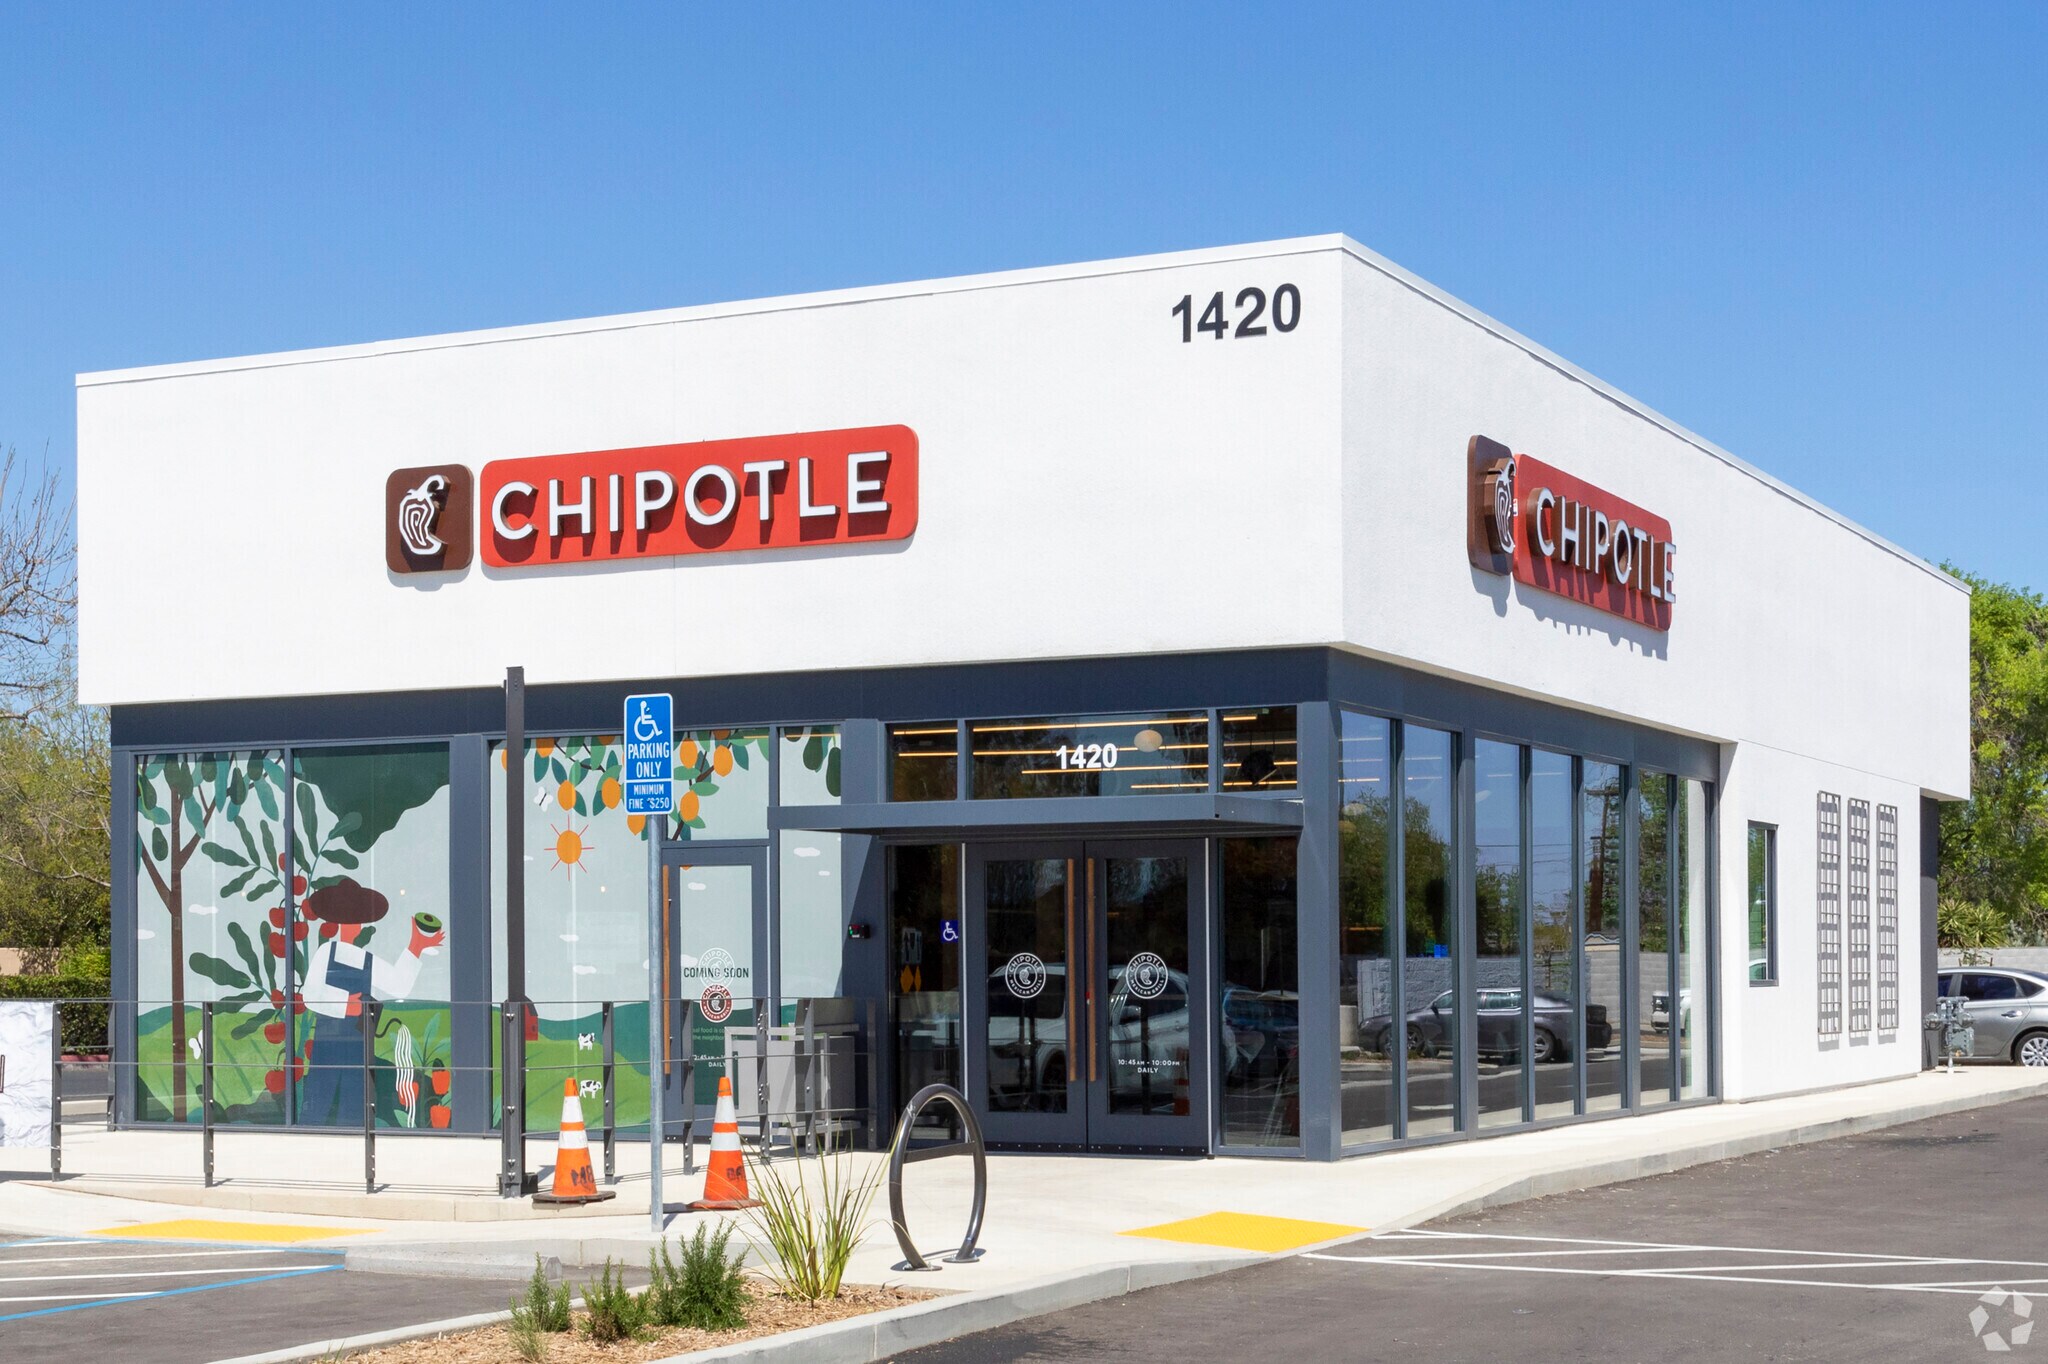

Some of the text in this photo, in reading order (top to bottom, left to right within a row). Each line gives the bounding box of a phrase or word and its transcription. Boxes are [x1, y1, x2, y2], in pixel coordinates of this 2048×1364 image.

[1172, 283, 1301, 343] 1420
[491, 451, 890, 540] CHIPOTLE
[1530, 487, 1677, 603] CHIPOTLE
[628, 742, 669, 759] PARKING
[1056, 743, 1117, 770] 1420
[636, 762, 661, 778] ONLY
[634, 784, 664, 795] MINIMUM
[629, 798, 644, 809] FINE
[1009, 956, 1042, 972] CHIPOTLE
[1130, 956, 1165, 972] CHIPOTLE
[683, 967, 749, 978] COMING SOON
